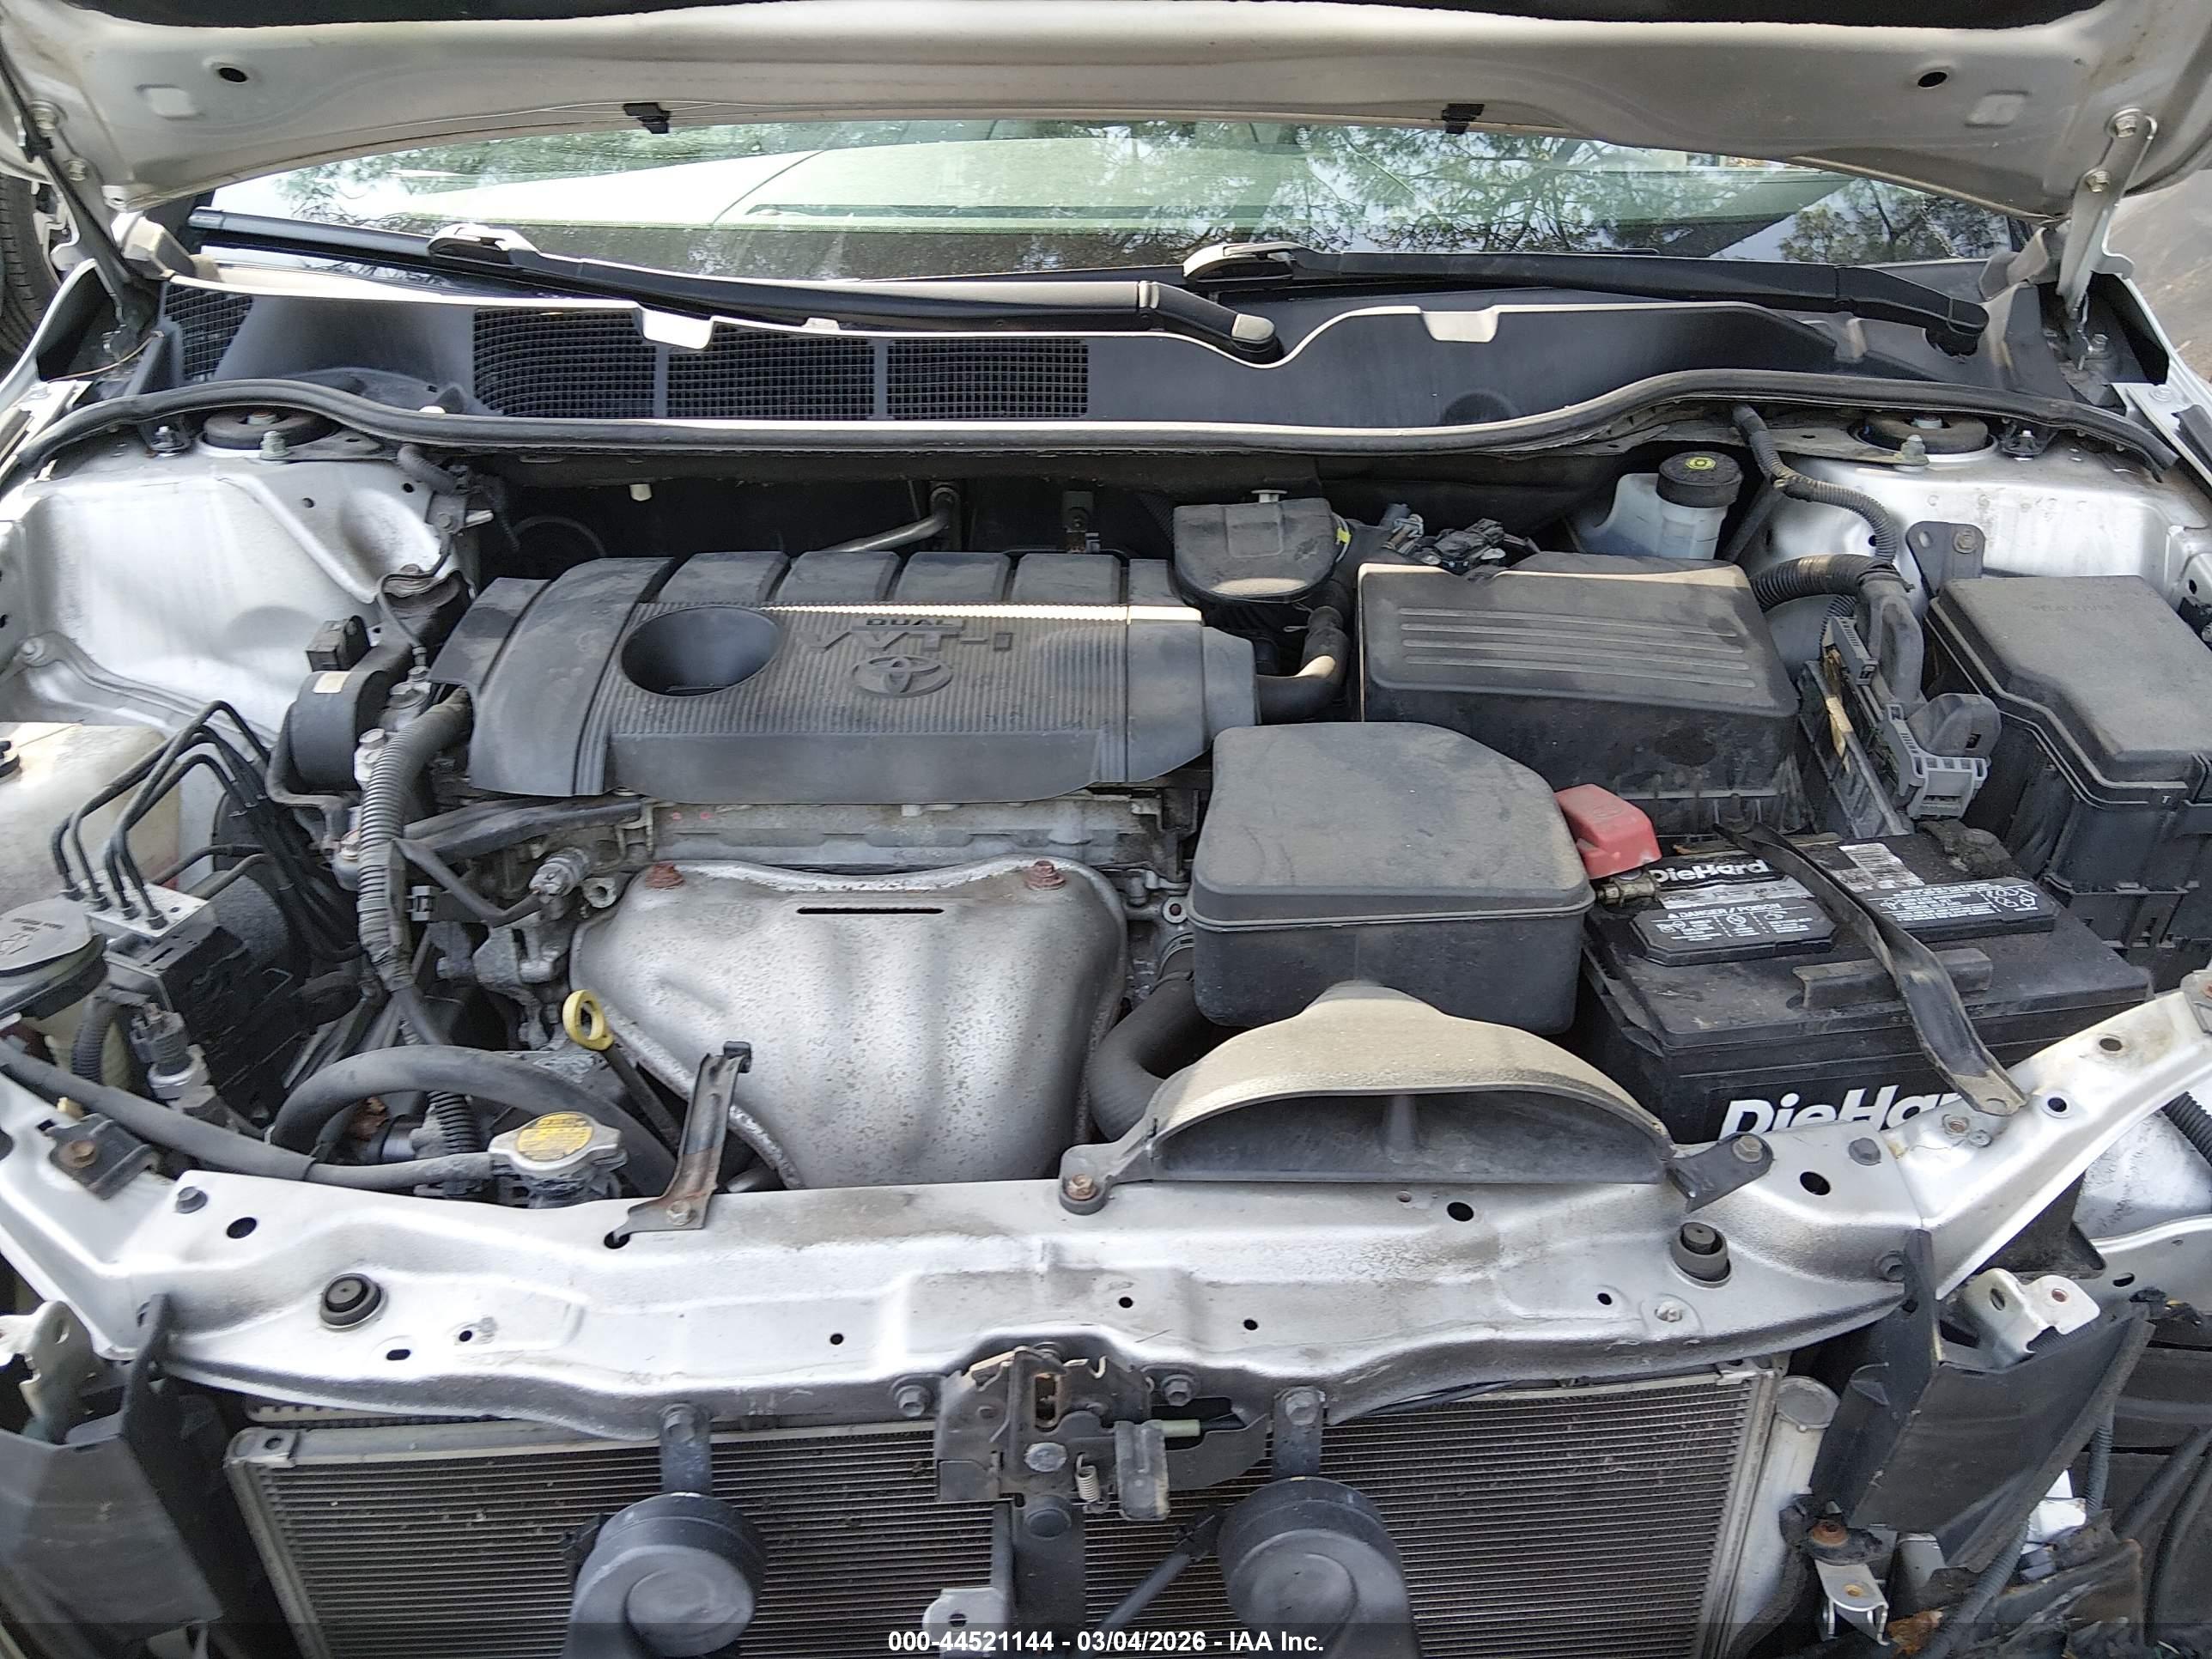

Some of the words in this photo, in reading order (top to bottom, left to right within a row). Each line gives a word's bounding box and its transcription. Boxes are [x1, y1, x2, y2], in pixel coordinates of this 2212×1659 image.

[866, 617, 956, 627] DUAL
[1649, 859, 1770, 883] DieHard
[1679, 908, 1729, 918] DANGER
[1737, 902, 1783, 913] POISON
